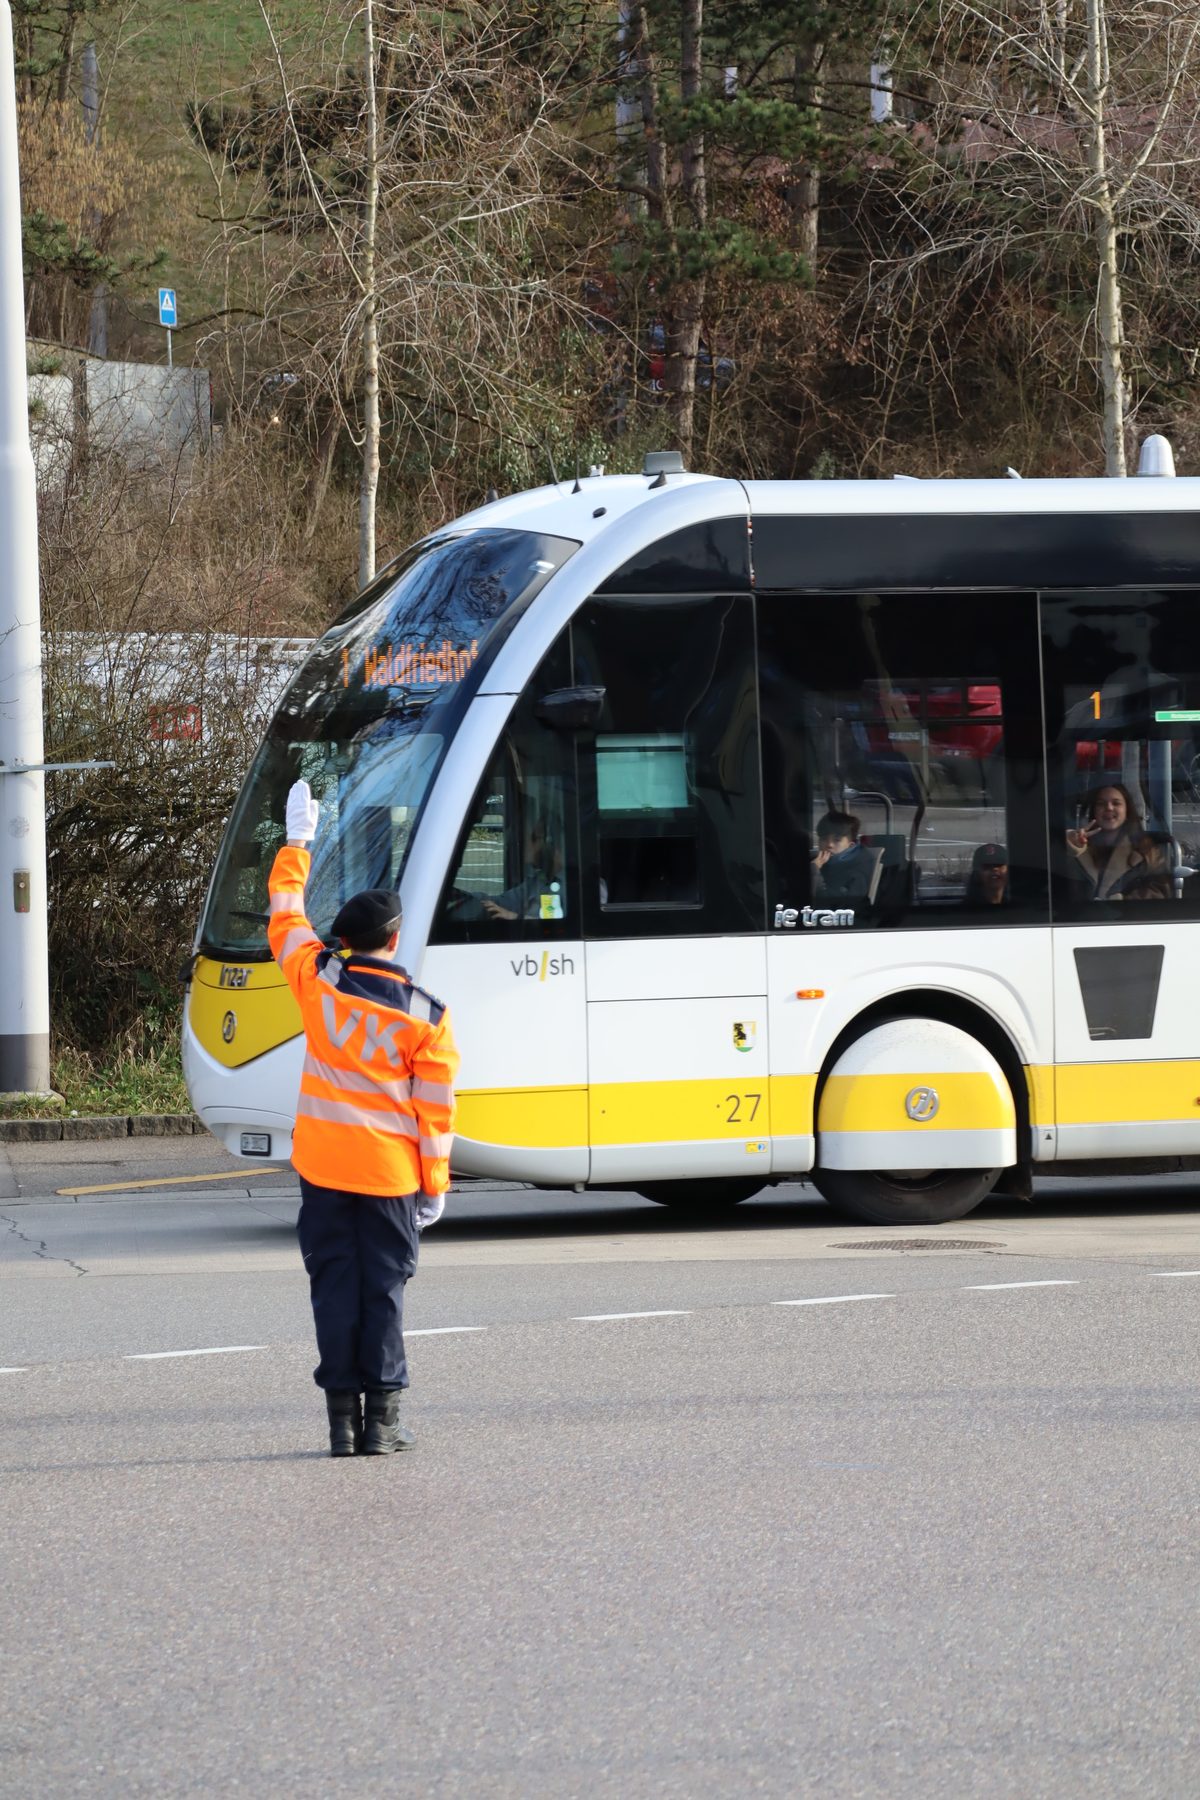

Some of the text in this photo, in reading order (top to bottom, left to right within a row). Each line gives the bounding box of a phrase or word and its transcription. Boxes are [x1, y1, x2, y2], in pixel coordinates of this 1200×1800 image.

[341, 648, 349, 688] 1
[1089, 691, 1101, 720] 1
[774, 903, 855, 928] ie tram
[321, 992, 411, 1068] VK
[725, 1093, 762, 1123] 27
